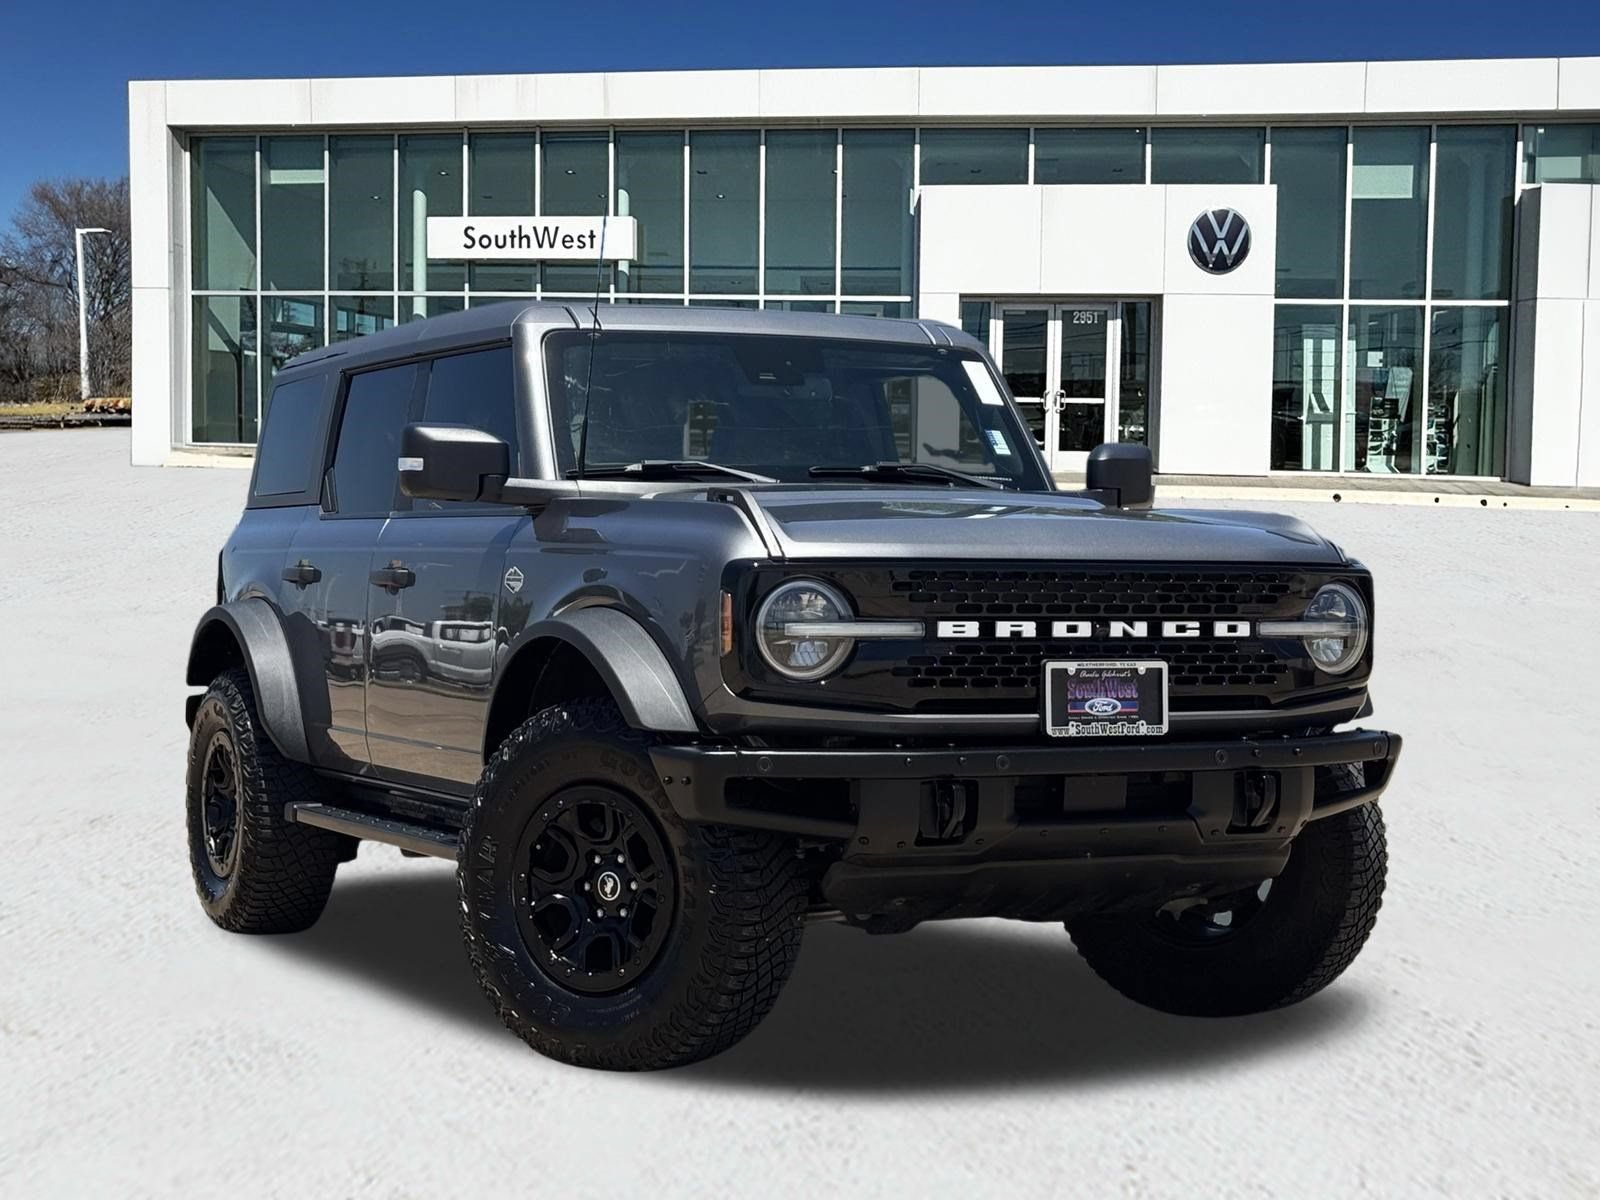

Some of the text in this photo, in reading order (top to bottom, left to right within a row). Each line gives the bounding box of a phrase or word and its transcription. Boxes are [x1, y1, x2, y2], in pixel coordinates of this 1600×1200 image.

[463, 224, 597, 250] SouthWest
[1190, 208, 1250, 269] VW
[1073, 311, 1098, 324] 2951
[936, 620, 1251, 638] BRONCO
[1067, 679, 1138, 698] SouthWest
[1092, 701, 1113, 712] Ford
[1051, 722, 1164, 737] www.SouthWestFord.com
